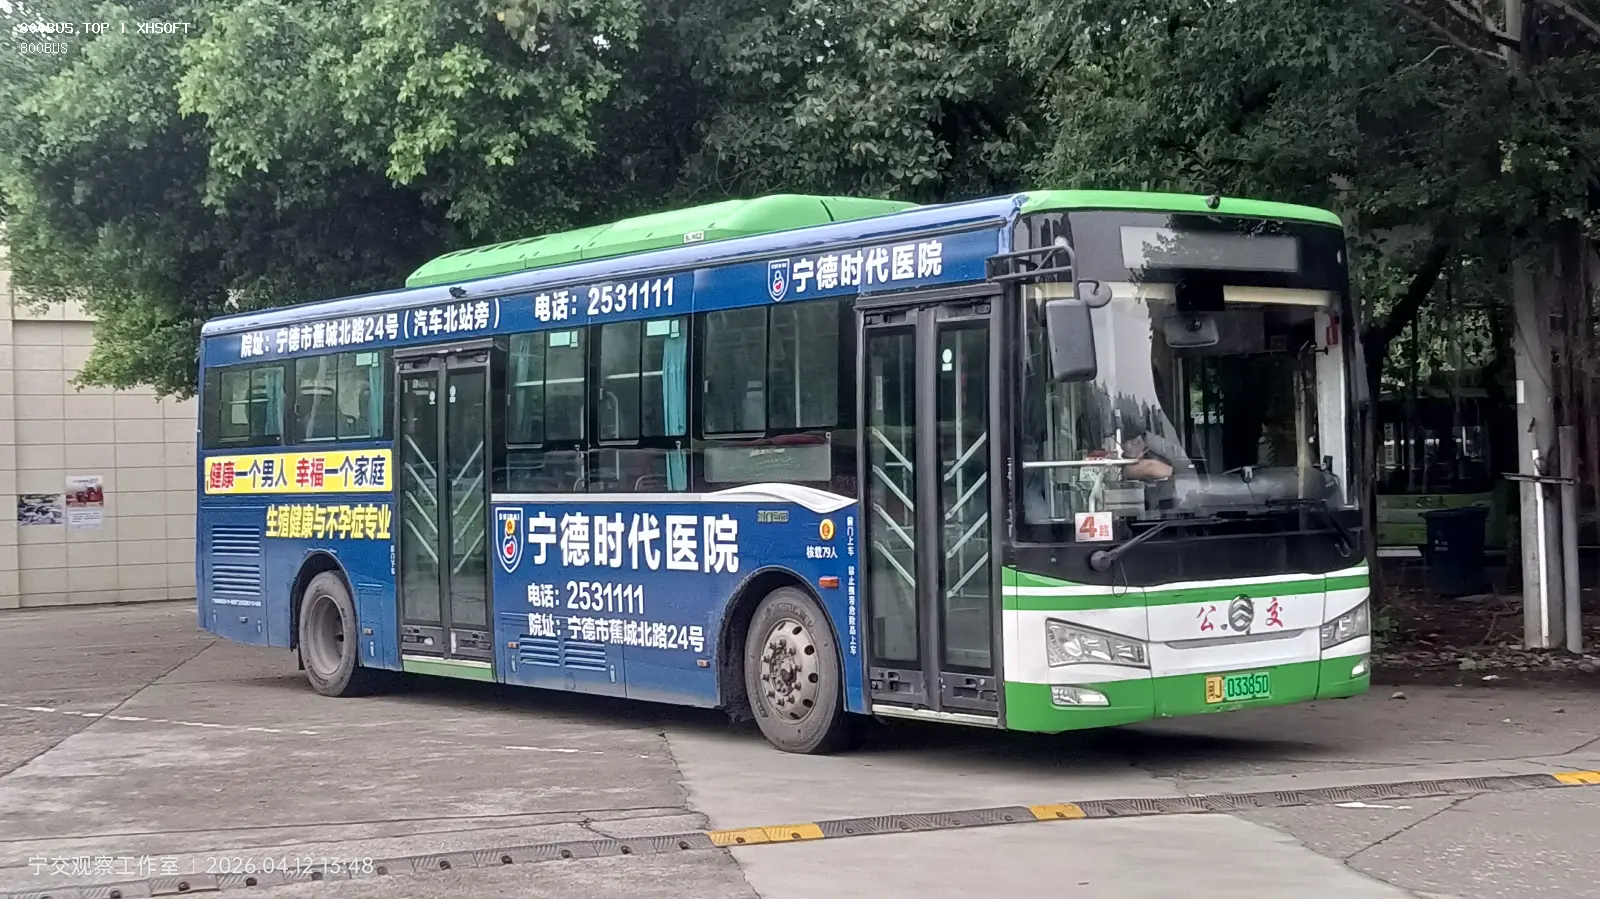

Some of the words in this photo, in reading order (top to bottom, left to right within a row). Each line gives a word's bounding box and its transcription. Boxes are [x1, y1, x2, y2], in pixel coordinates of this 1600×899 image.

[792, 240, 943, 293] 宁德时代医院
[209, 458, 288, 489] 健康一个男人
[295, 455, 386, 488] 幸福一个家庭
[265, 504, 392, 540] 生殖健康与不孕症专业
[527, 511, 740, 574] 宁德时代医院
[806, 545, 839, 559] 核载79人
[1227, 674, 1269, 698] 03385D
